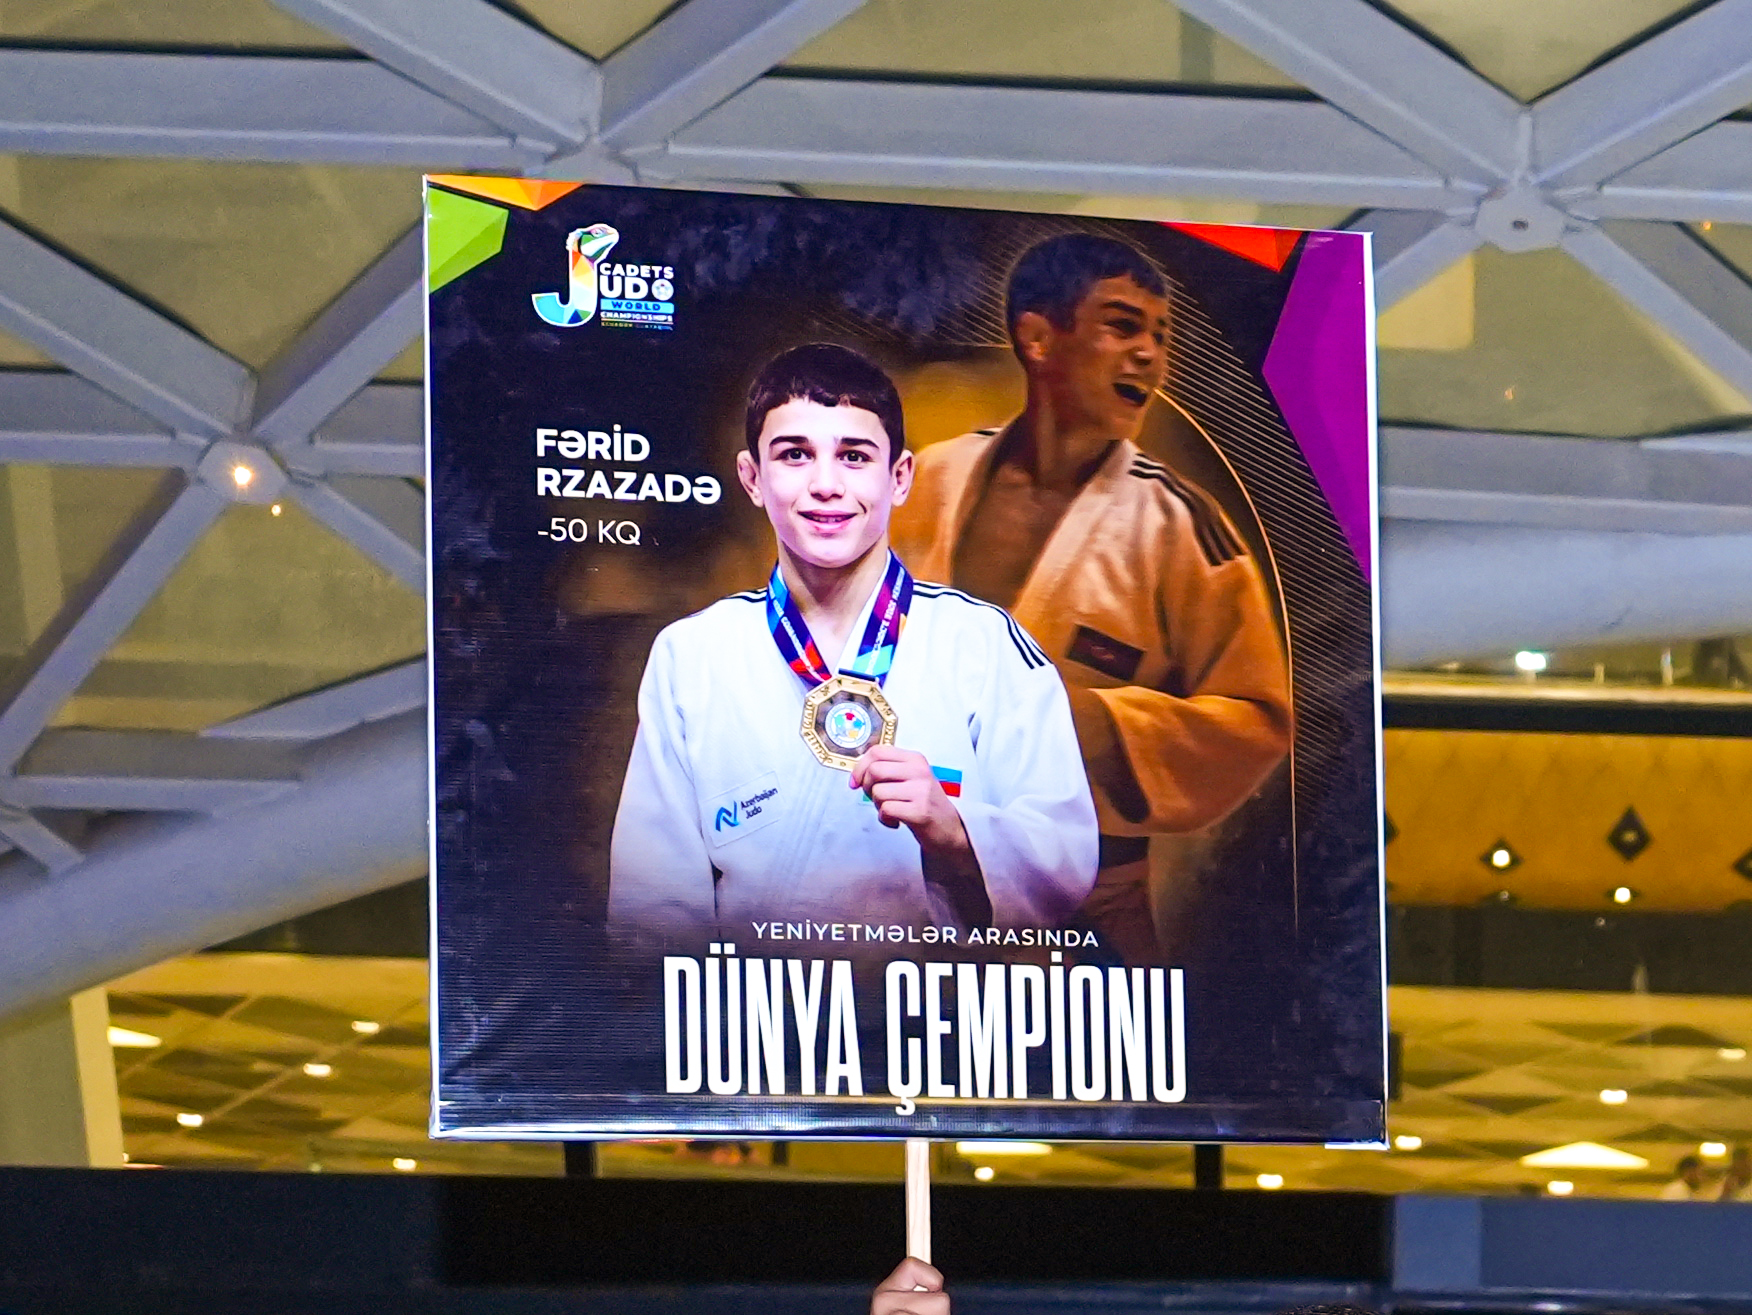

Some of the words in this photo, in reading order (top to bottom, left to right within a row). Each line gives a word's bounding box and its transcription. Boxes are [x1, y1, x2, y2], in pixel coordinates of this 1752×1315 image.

[600, 263, 674, 279] CADETS
[600, 311, 673, 321] CHAMPIONSHIPS
[611, 301, 661, 311] WORLD
[537, 424, 650, 461] FƏRİD
[537, 467, 721, 504] RZAZADƏ
[537, 518, 588, 542] -50
[598, 519, 641, 545] KQ
[751, 919, 957, 944] YENİYETMƏLƏR
[967, 927, 1098, 948] ARASINDA
[663, 942, 863, 1096] DÜNYA
[885, 951, 1186, 1116] ÇEMPİONU
